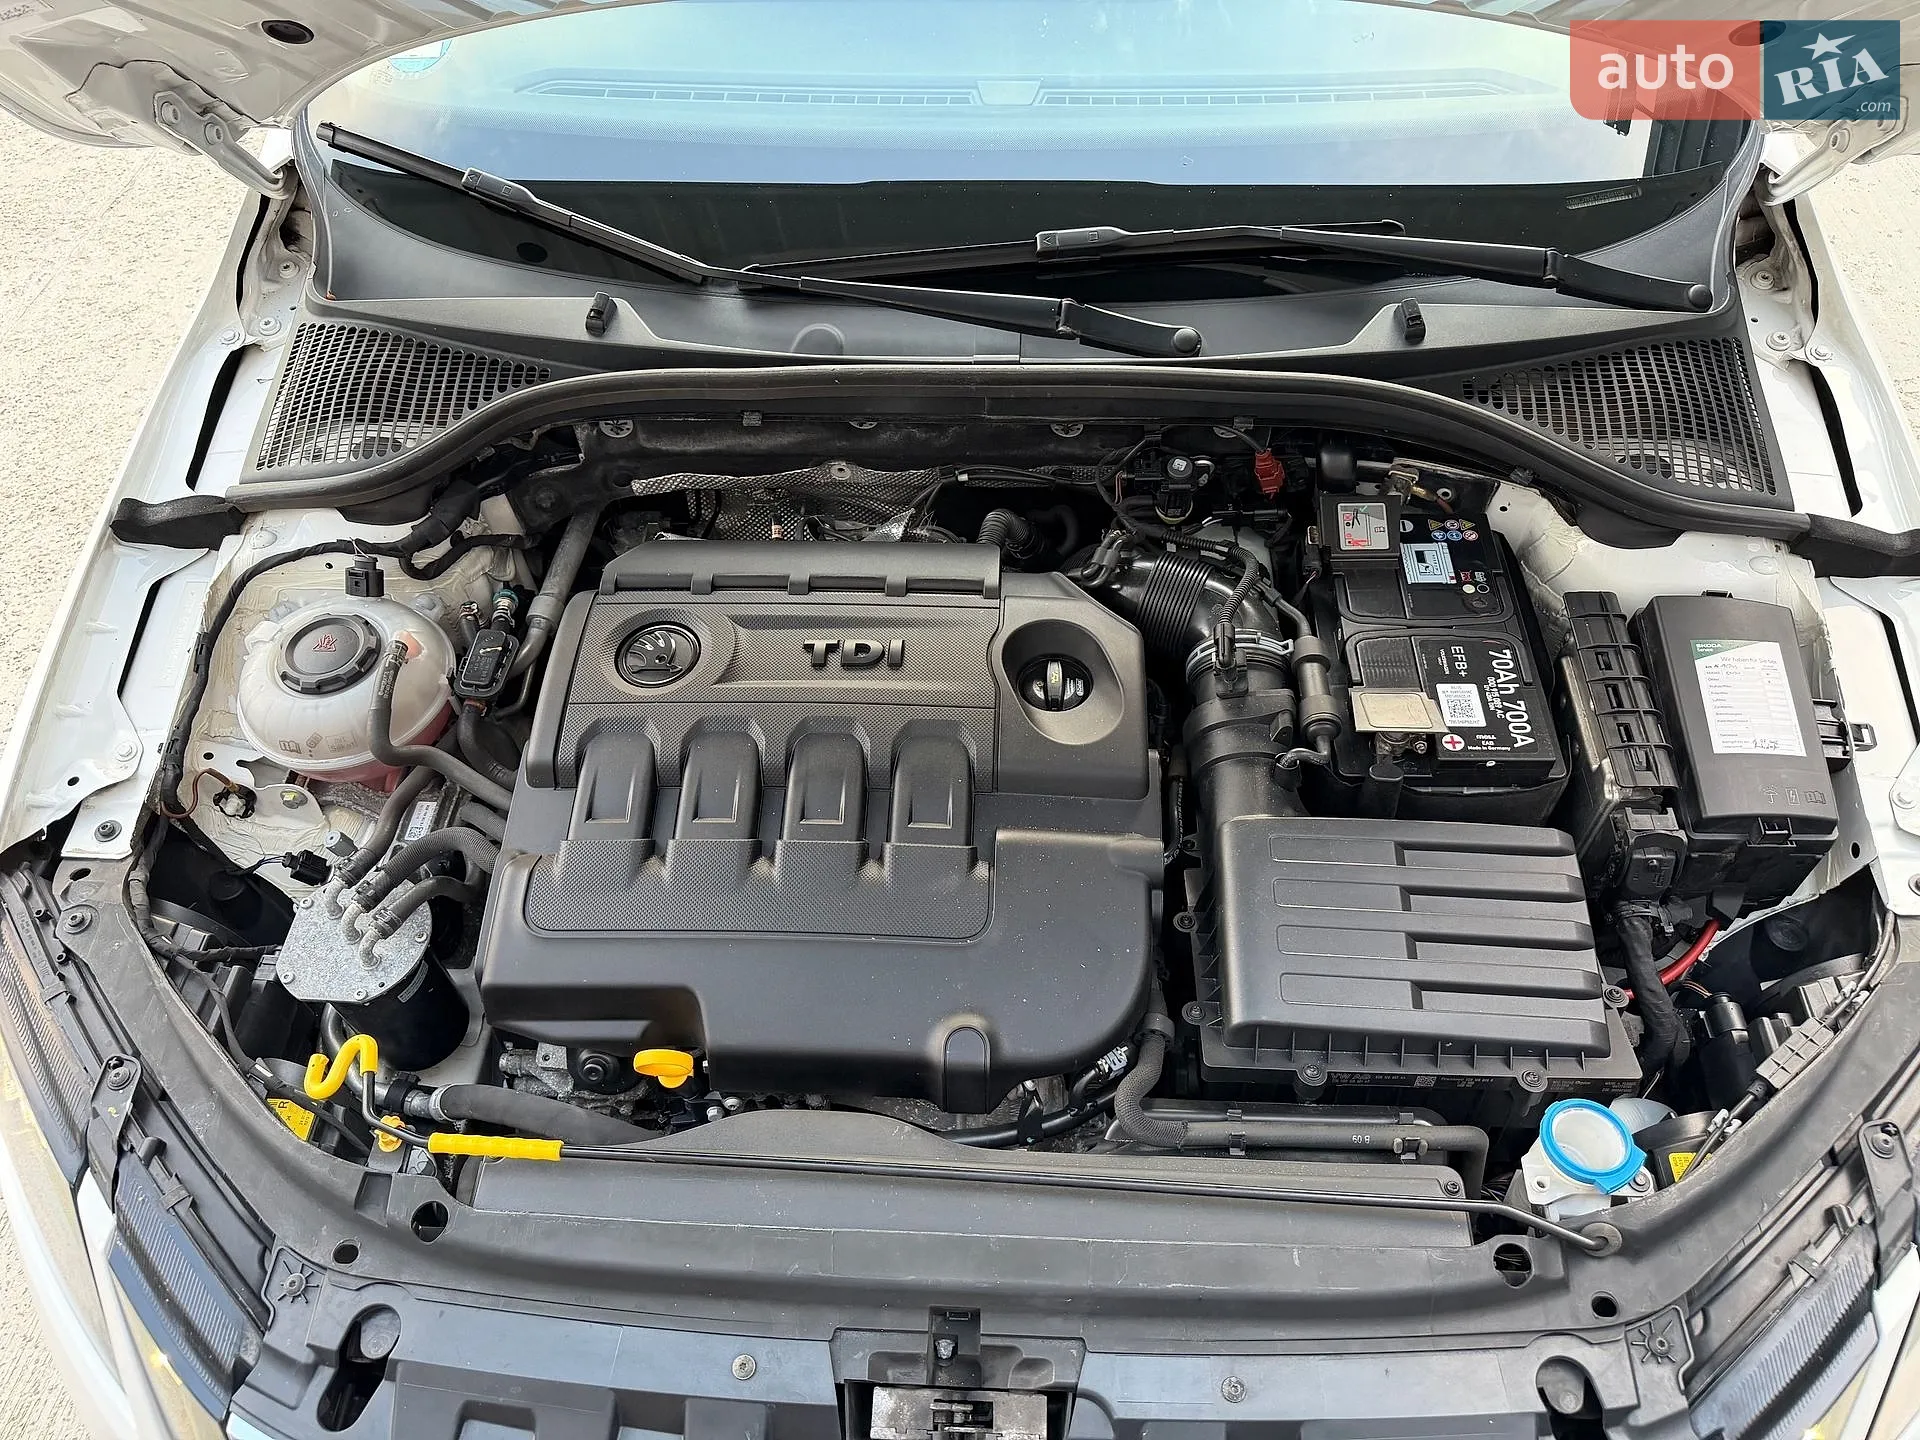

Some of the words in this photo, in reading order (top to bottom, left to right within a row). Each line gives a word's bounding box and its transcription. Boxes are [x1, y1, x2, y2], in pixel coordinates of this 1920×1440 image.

[803, 639, 904, 667] TDI
[1451, 646, 1468, 677] EFB+
[1489, 649, 1520, 694] 70Ah
[1503, 700, 1535, 748] 700A
